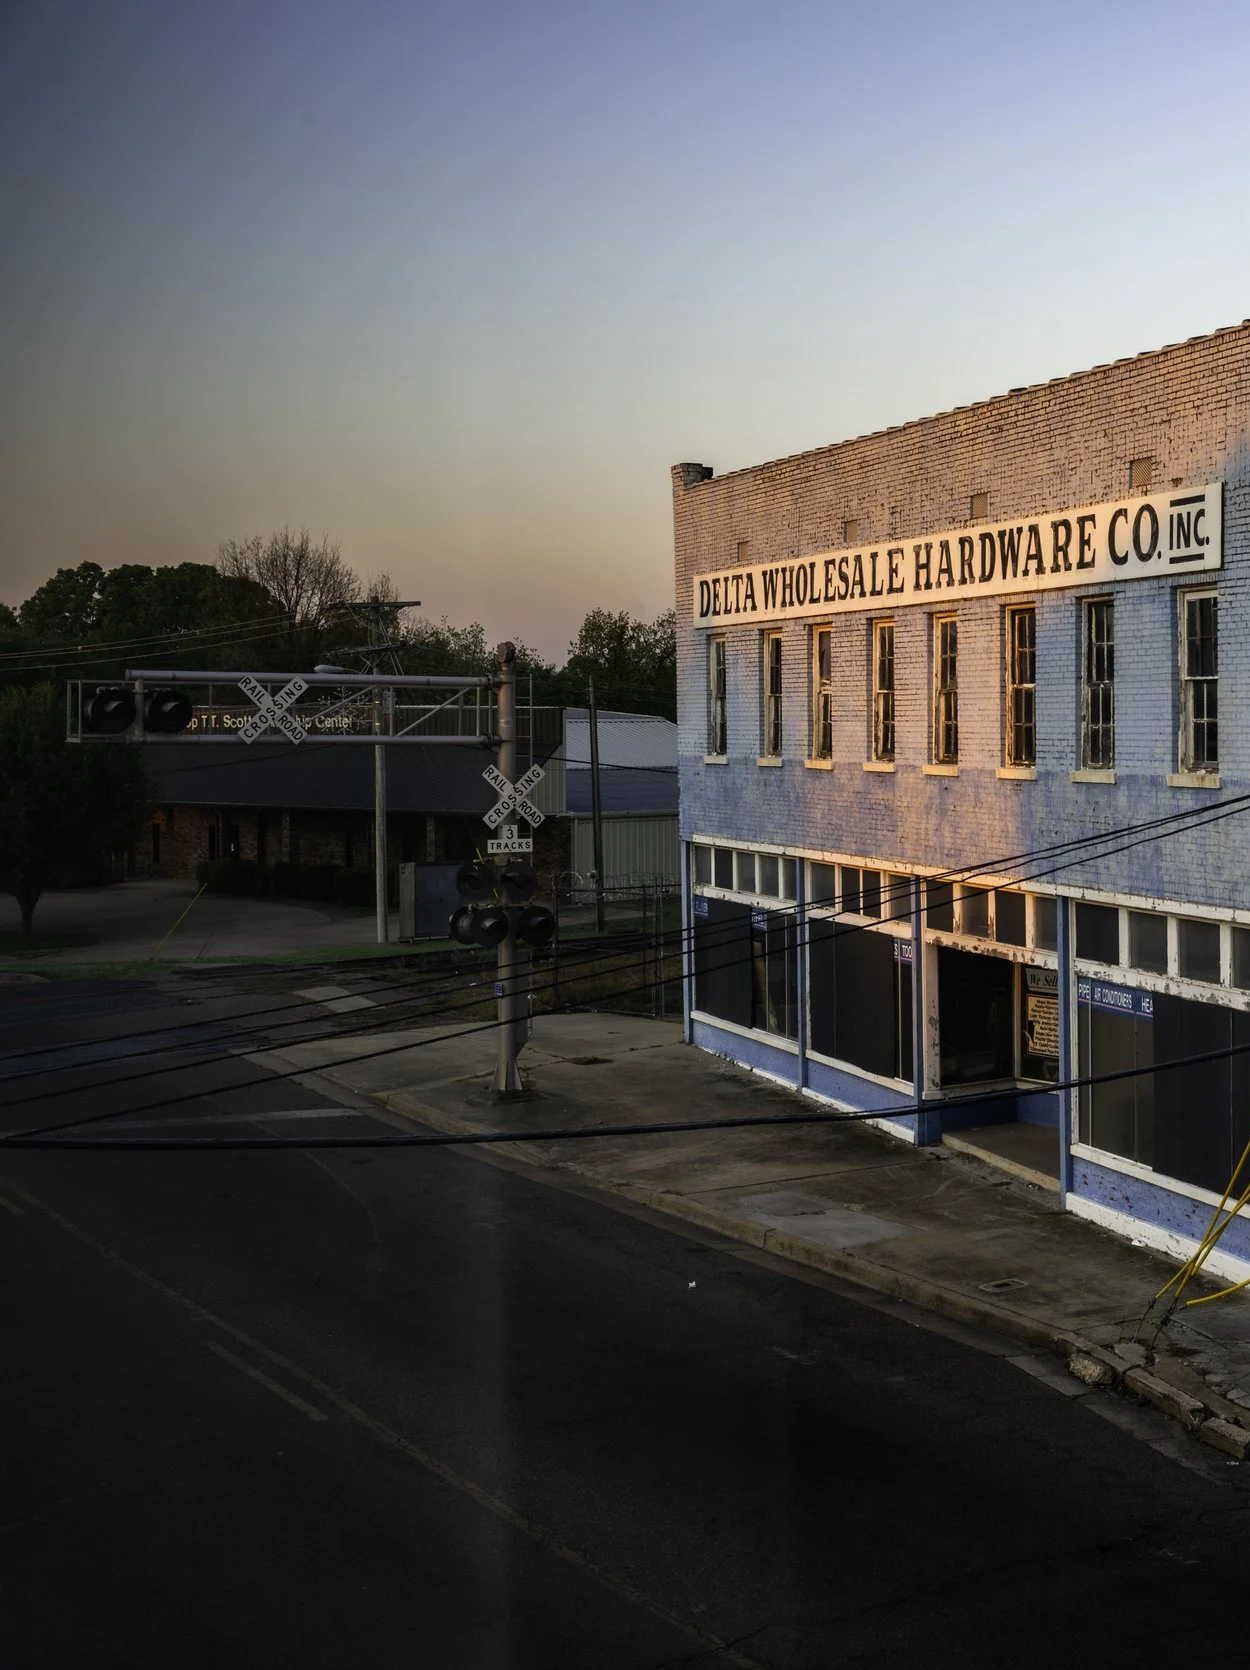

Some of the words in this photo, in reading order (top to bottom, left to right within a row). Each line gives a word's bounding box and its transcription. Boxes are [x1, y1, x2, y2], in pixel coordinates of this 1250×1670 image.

[699, 572, 757, 618] DELTA
[762, 548, 905, 610] WHOLESALE
[913, 513, 1097, 592] HARDWARE
[1108, 503, 1162, 566] CO.
[1169, 508, 1210, 551] INC.
[241, 676, 267, 704] RAIL
[277, 714, 304, 741] ROAD
[243, 681, 304, 739] CROSSING
[315, 714, 353, 729] Center
[484, 767, 507, 792] RAIL
[518, 800, 542, 824] ROAD
[488, 769, 541, 824] CROSSING
[490, 841, 531, 850] TRACKS
[506, 828, 514, 840] 3
[1078, 983, 1090, 999] PIPE
[1101, 988, 1133, 1009] CONDITIONERS
